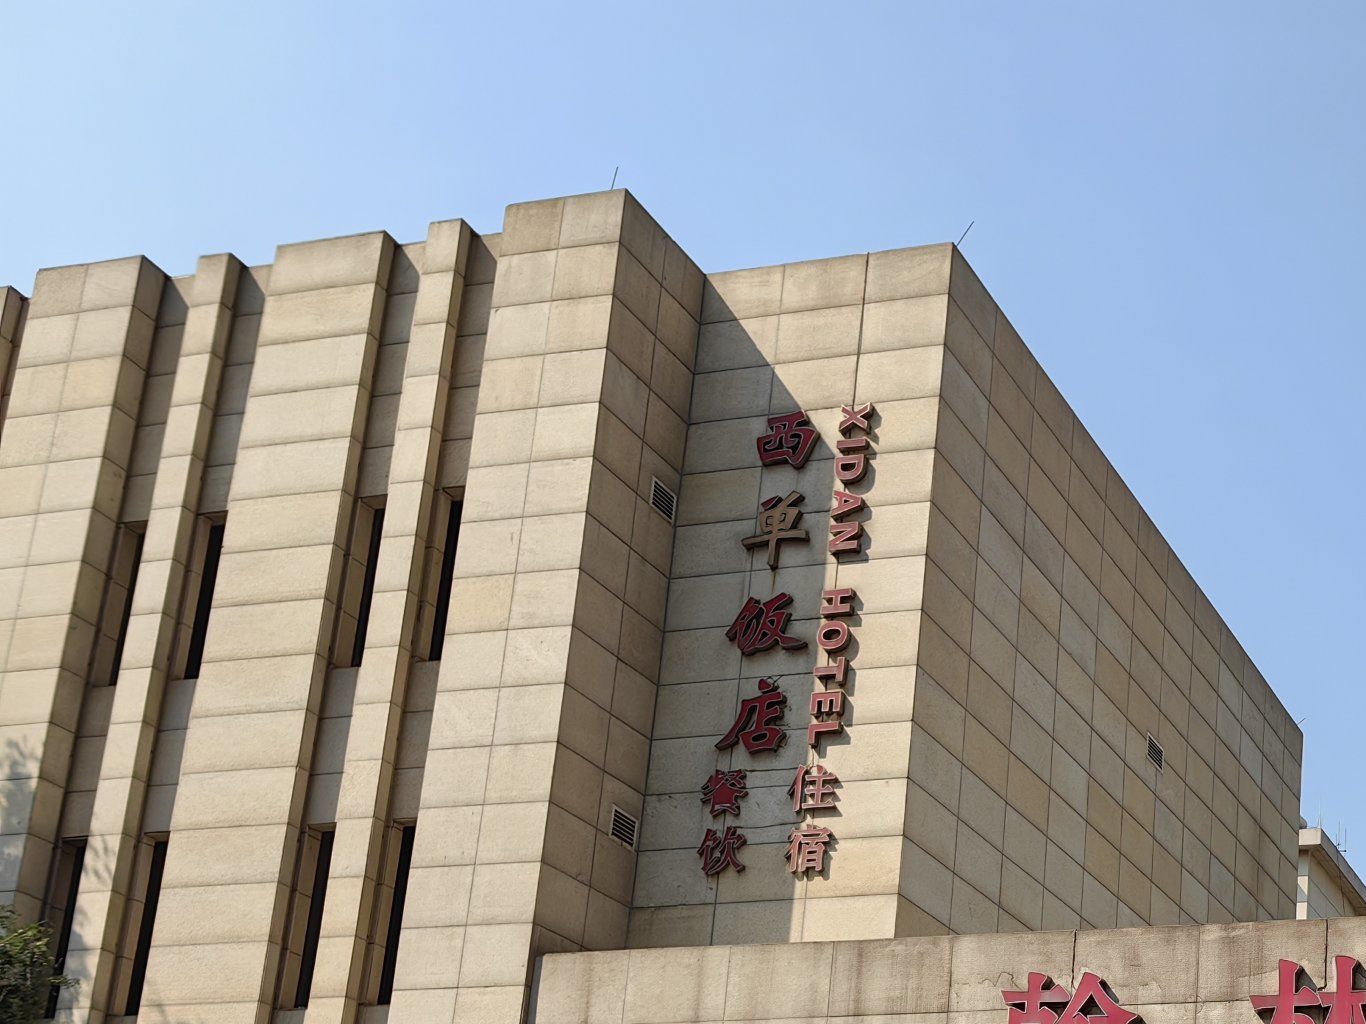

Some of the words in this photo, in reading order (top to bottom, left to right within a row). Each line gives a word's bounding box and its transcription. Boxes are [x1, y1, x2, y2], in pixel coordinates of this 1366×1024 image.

[829, 402, 876, 556] XIDAN
[714, 409, 820, 755] 西单饭店
[808, 587, 858, 748] HOTEL
[697, 768, 747, 876] 餐饮
[786, 764, 839, 874] 住宿
